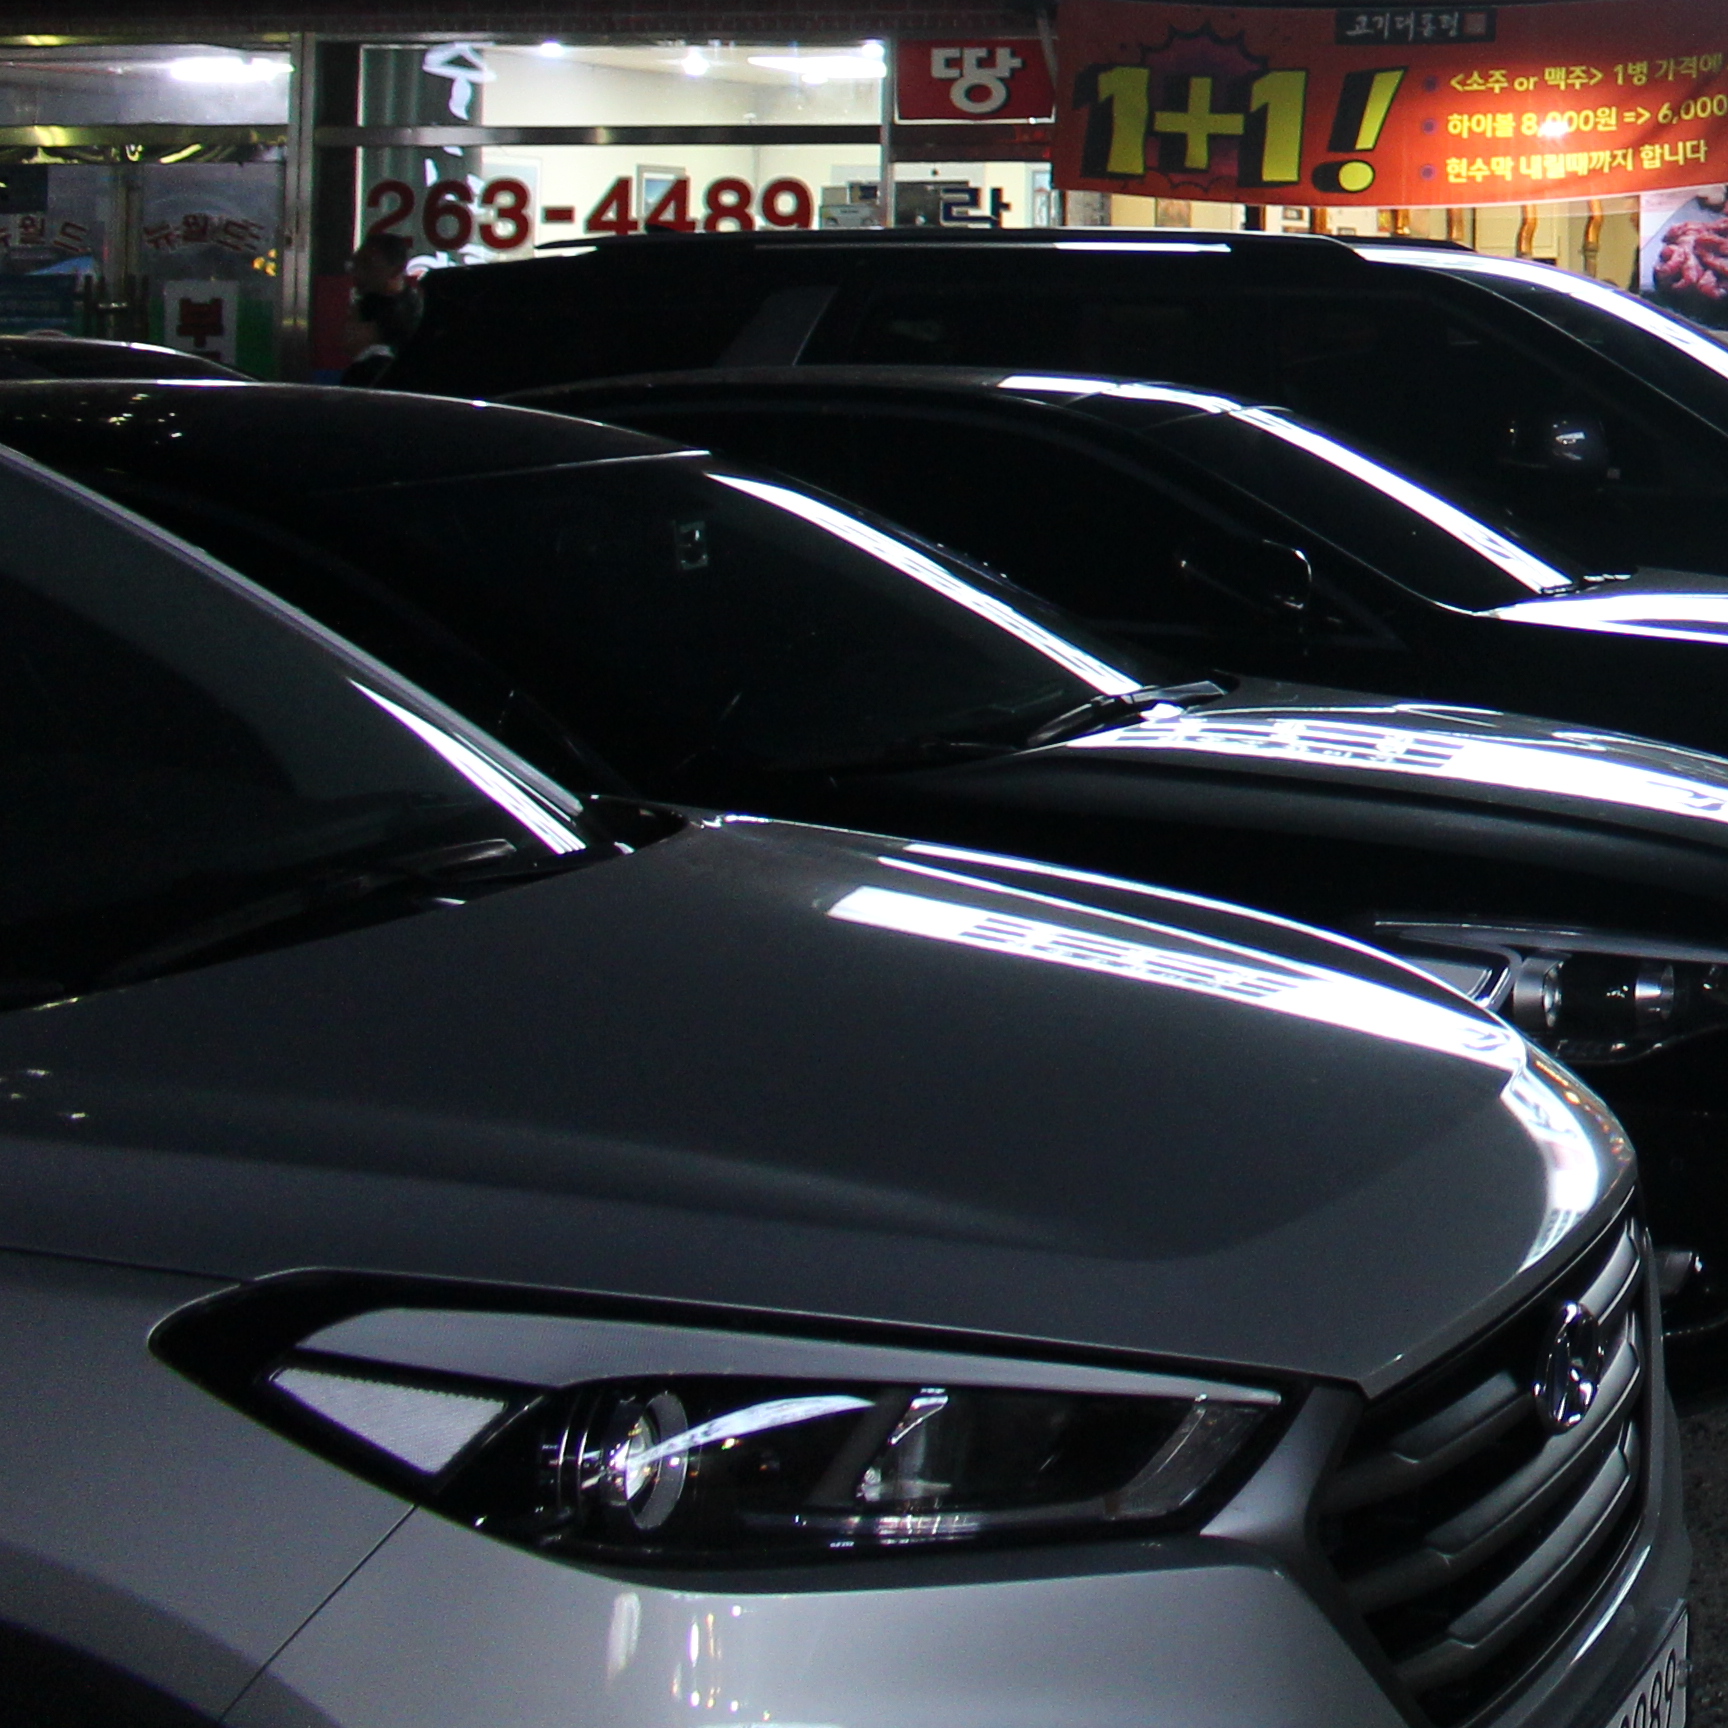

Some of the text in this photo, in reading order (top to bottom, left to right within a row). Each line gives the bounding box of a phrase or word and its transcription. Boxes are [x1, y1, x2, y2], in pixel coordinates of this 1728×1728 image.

[931, 47, 1022, 114] 땅
[1513, 73, 1538, 92] or
[1614, 59, 1648, 86] 1병
[1654, 52, 1723, 81] 가격에
[1447, 112, 1515, 139] 하이볼
[1445, 138, 1708, 184] 현수막 내릴때까지 합니다
[367, 176, 814, 251] 263-4489
